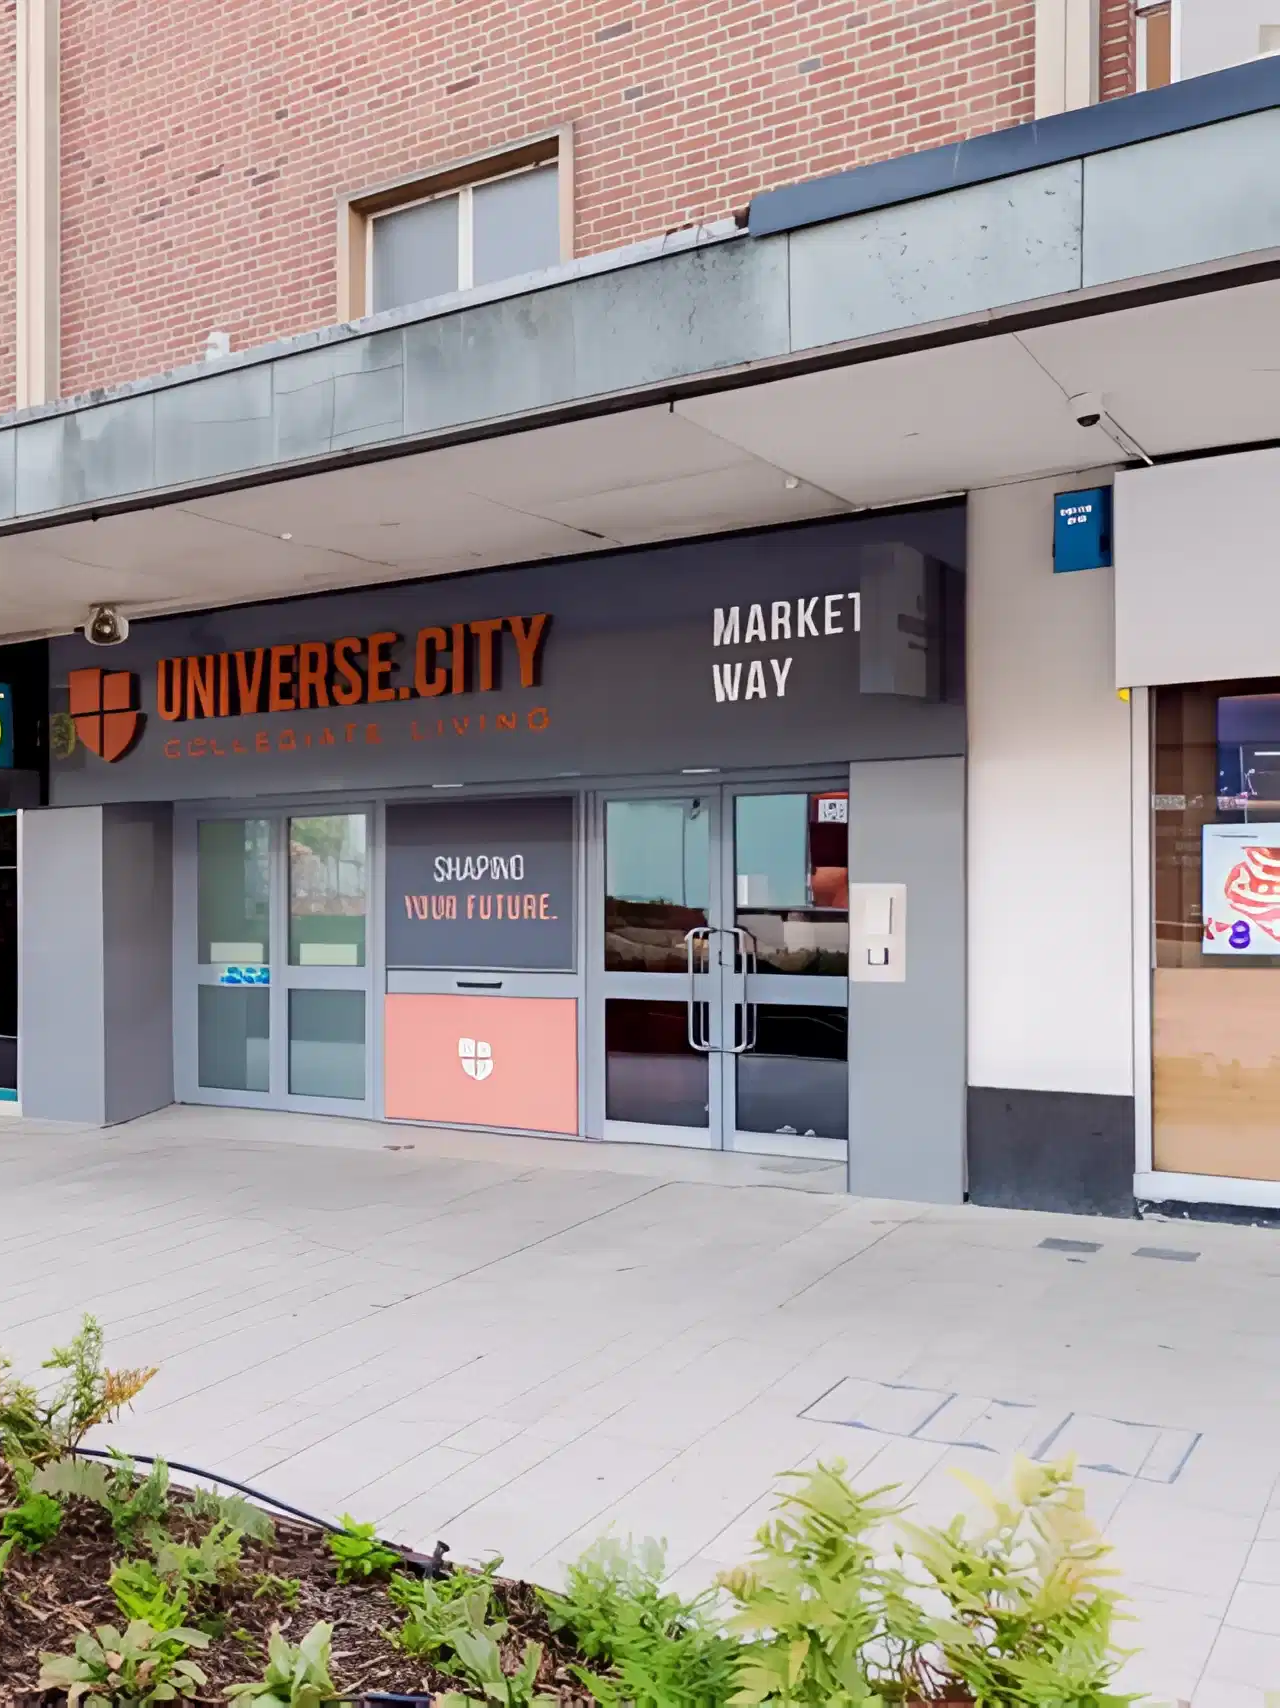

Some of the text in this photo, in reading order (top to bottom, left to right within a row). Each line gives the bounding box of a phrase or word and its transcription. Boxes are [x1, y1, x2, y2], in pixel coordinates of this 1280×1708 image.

[713, 592, 860, 646] MARKET
[156, 613, 548, 721] UNIVERSE.CITY
[712, 657, 793, 703] WAY
